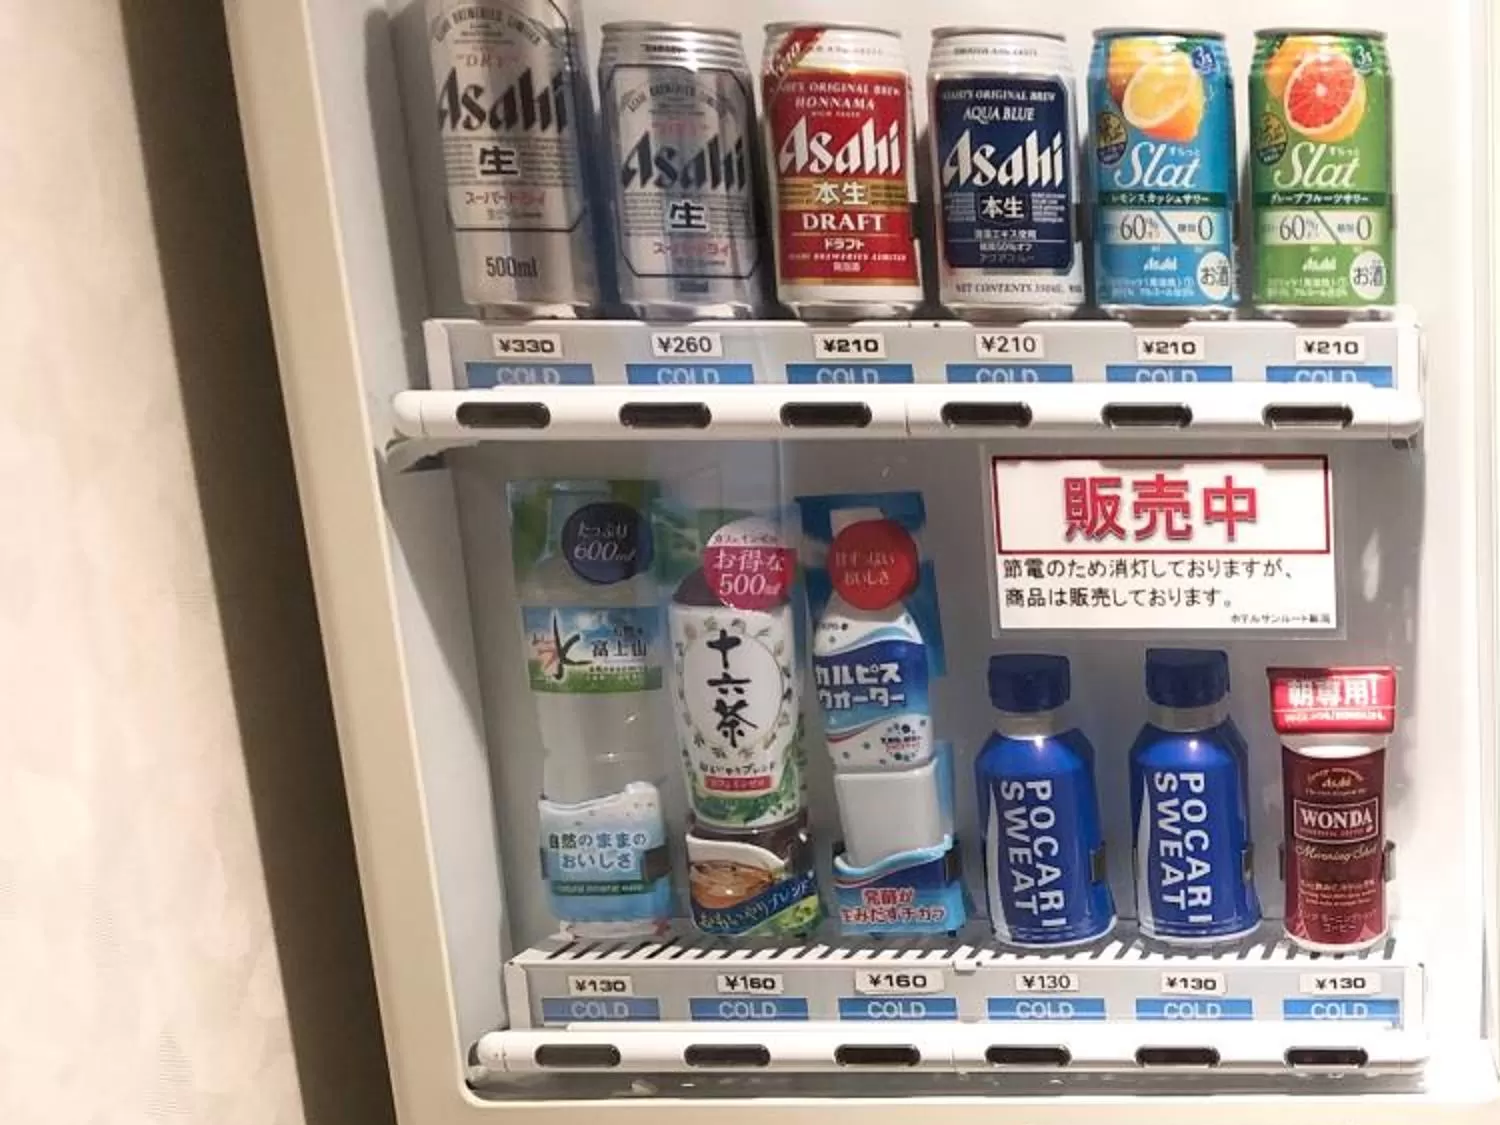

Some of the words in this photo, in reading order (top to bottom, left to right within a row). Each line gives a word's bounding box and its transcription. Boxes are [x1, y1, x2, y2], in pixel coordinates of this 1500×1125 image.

[810, 82, 868, 94] ORIGINAL
[976, 90, 1026, 100] ORIGINAL
[1030, 91, 1056, 101] BREW
[437, 66, 568, 133] Asahi
[796, 96, 875, 111] HONNAMA
[963, 106, 1000, 124] AQUA
[1003, 107, 1035, 121] BLUE
[779, 116, 901, 175] Asahi
[479, 146, 519, 175] 生
[622, 131, 746, 190] Asahi
[942, 129, 1063, 188] Asahi
[1114, 141, 1201, 188] Slat
[1273, 141, 1361, 188] Slat
[813, 181, 868, 205] 本生
[670, 202, 707, 229] 生
[981, 196, 1025, 218] 本生
[802, 213, 885, 231] DRAFT
[824, 238, 864, 250] ドラフト
[486, 256, 538, 277] 500ml
[1201, 266, 1229, 286] お酒
[1353, 266, 1384, 286] お酒
[975, 284, 1033, 294] CONTENTS
[500, 339, 555, 353] ¥330
[658, 336, 712, 352] ¥260
[824, 339, 879, 353] ¥210
[981, 337, 1037, 353] ¥210
[1144, 341, 1196, 354] ¥210
[1304, 340, 1359, 354] ¥210
[1063, 473, 1258, 542] 販売中
[577, 521, 629, 538] たっぷり
[574, 542, 636, 561] 600ml
[714, 549, 785, 572] お得な
[1003, 558, 1292, 578] 節電のため消灯しておりますが、
[1005, 588, 1232, 608] 商品は販売しております。
[816, 661, 903, 685] カルピス
[706, 629, 758, 748] 十六茶
[1300, 807, 1373, 829] WONDA
[549, 833, 647, 849] 自然のままの
[1001, 780, 1038, 916] SWEAT
[1154, 771, 1186, 911] SWEAT
[1179, 772, 1213, 923] POCARI
[562, 853, 632, 869] おいしさ
[1025, 779, 1067, 928] POCARI
[575, 980, 626, 993] ¥130
[726, 977, 776, 990] ¥160
[869, 974, 927, 988] ¥160
[1023, 975, 1071, 990] ¥130
[1166, 977, 1216, 991] ¥130
[1316, 977, 1366, 990] ¥130
[571, 1002, 629, 1019] COLD
[718, 1002, 777, 1019] COLD
[867, 1002, 925, 1019] COLD
[1016, 1002, 1073, 1019] COLD
[1164, 1003, 1221, 1019] COLD
[1311, 1003, 1369, 1019] COLD
